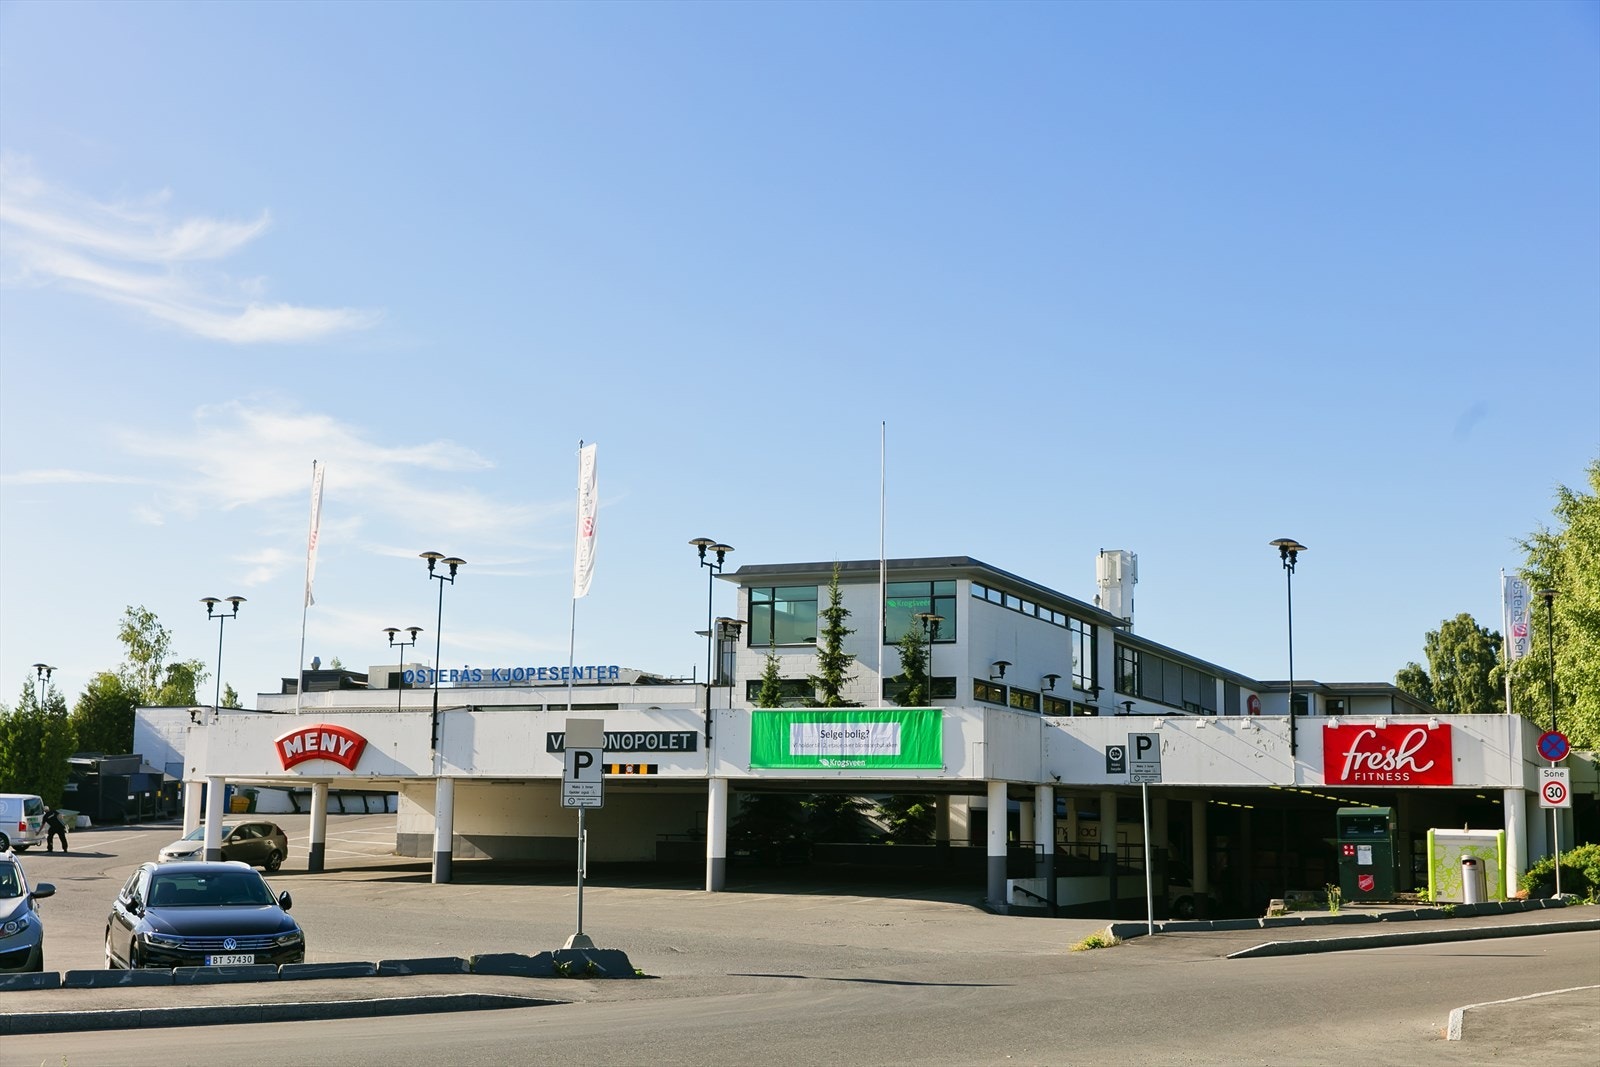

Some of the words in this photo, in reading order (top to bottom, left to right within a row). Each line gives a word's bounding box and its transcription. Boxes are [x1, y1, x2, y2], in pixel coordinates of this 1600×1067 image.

[403, 665, 482, 683] ØSTERÅS
[492, 665, 619, 682] KJØPESENTER
[551, 733, 690, 750] VNOPOLET
[820, 729, 843, 740] Selge
[845, 729, 870, 740] bolig?
[283, 732, 354, 758] MENY
[1136, 736, 1152, 760] P
[1341, 728, 1434, 780] fresh
[574, 751, 593, 779] P
[829, 759, 865, 768] Krogsveen
[1547, 787, 1562, 798] 30
[213, 956, 223, 964] BT
[227, 955, 252, 963] 57430
